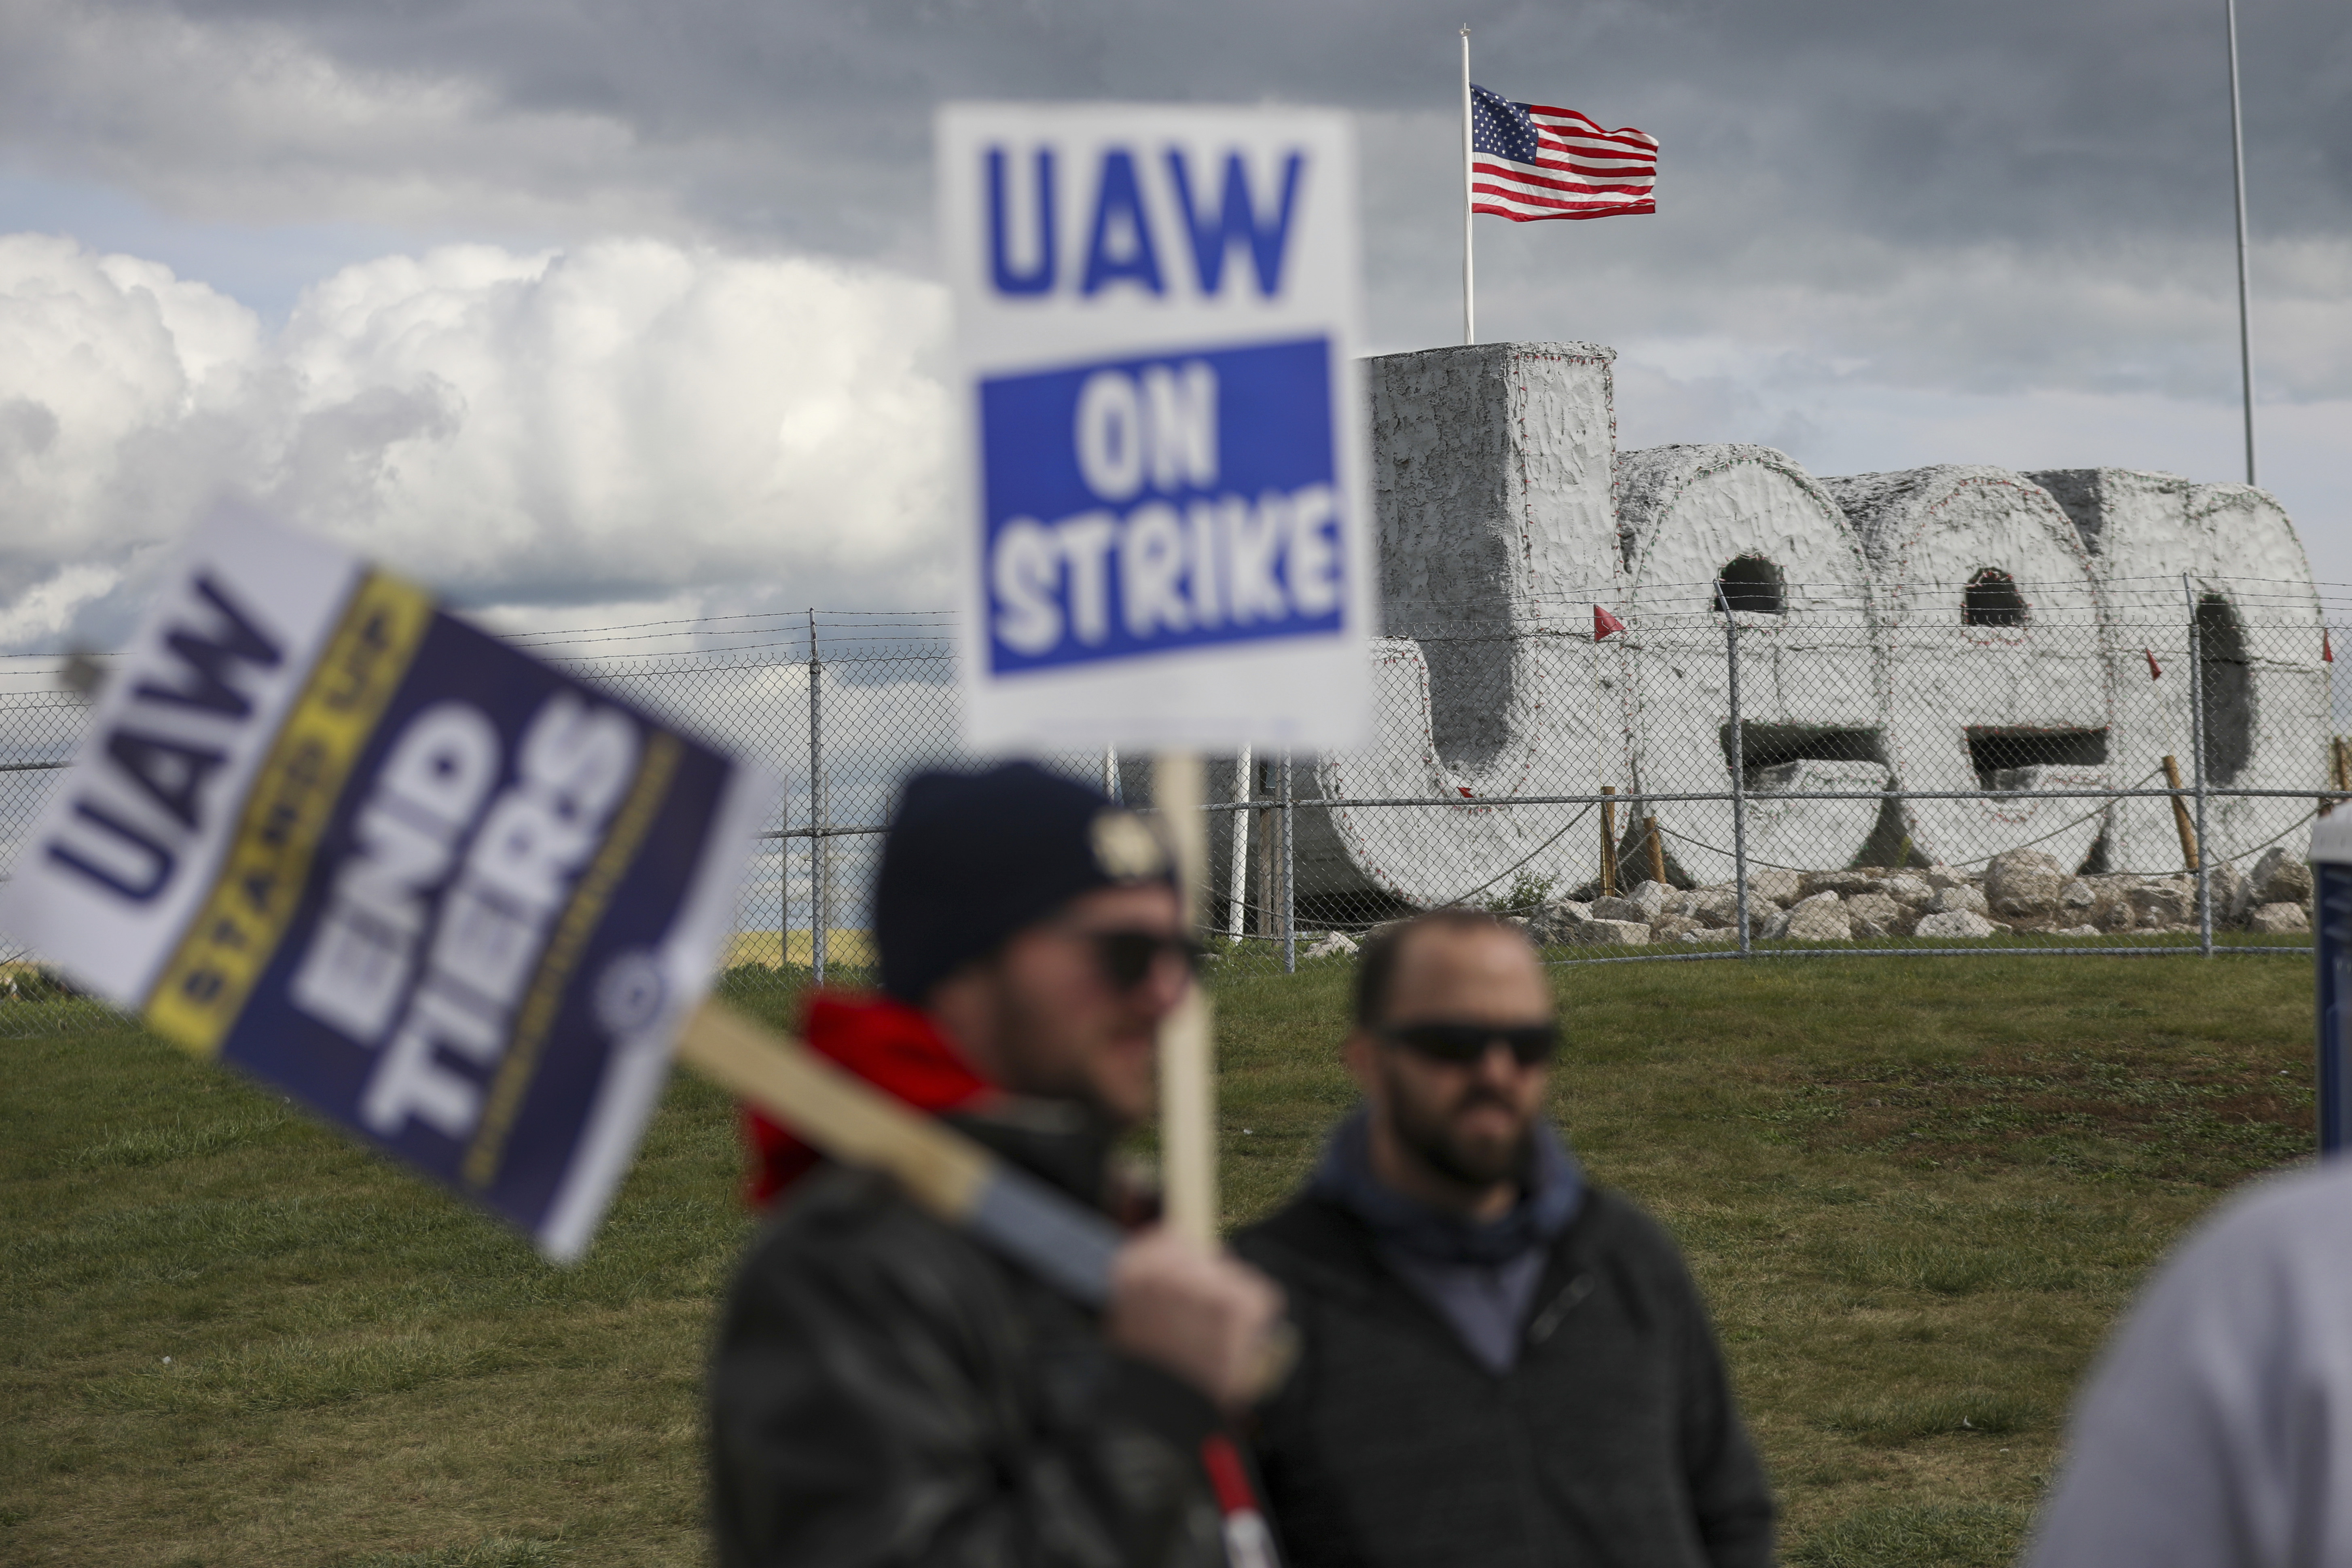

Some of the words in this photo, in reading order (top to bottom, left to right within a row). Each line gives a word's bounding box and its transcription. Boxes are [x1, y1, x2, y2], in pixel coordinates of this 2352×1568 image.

[982, 142, 1306, 302] UAW
[991, 481, 1343, 656] STRIKE
[1074, 359, 1221, 503] ON
[42, 566, 287, 906] UAW
[179, 737, 330, 1007] STAND
[326, 607, 392, 715] UP
[289, 699, 504, 1047] END
[360, 690, 643, 1137] TIERS
